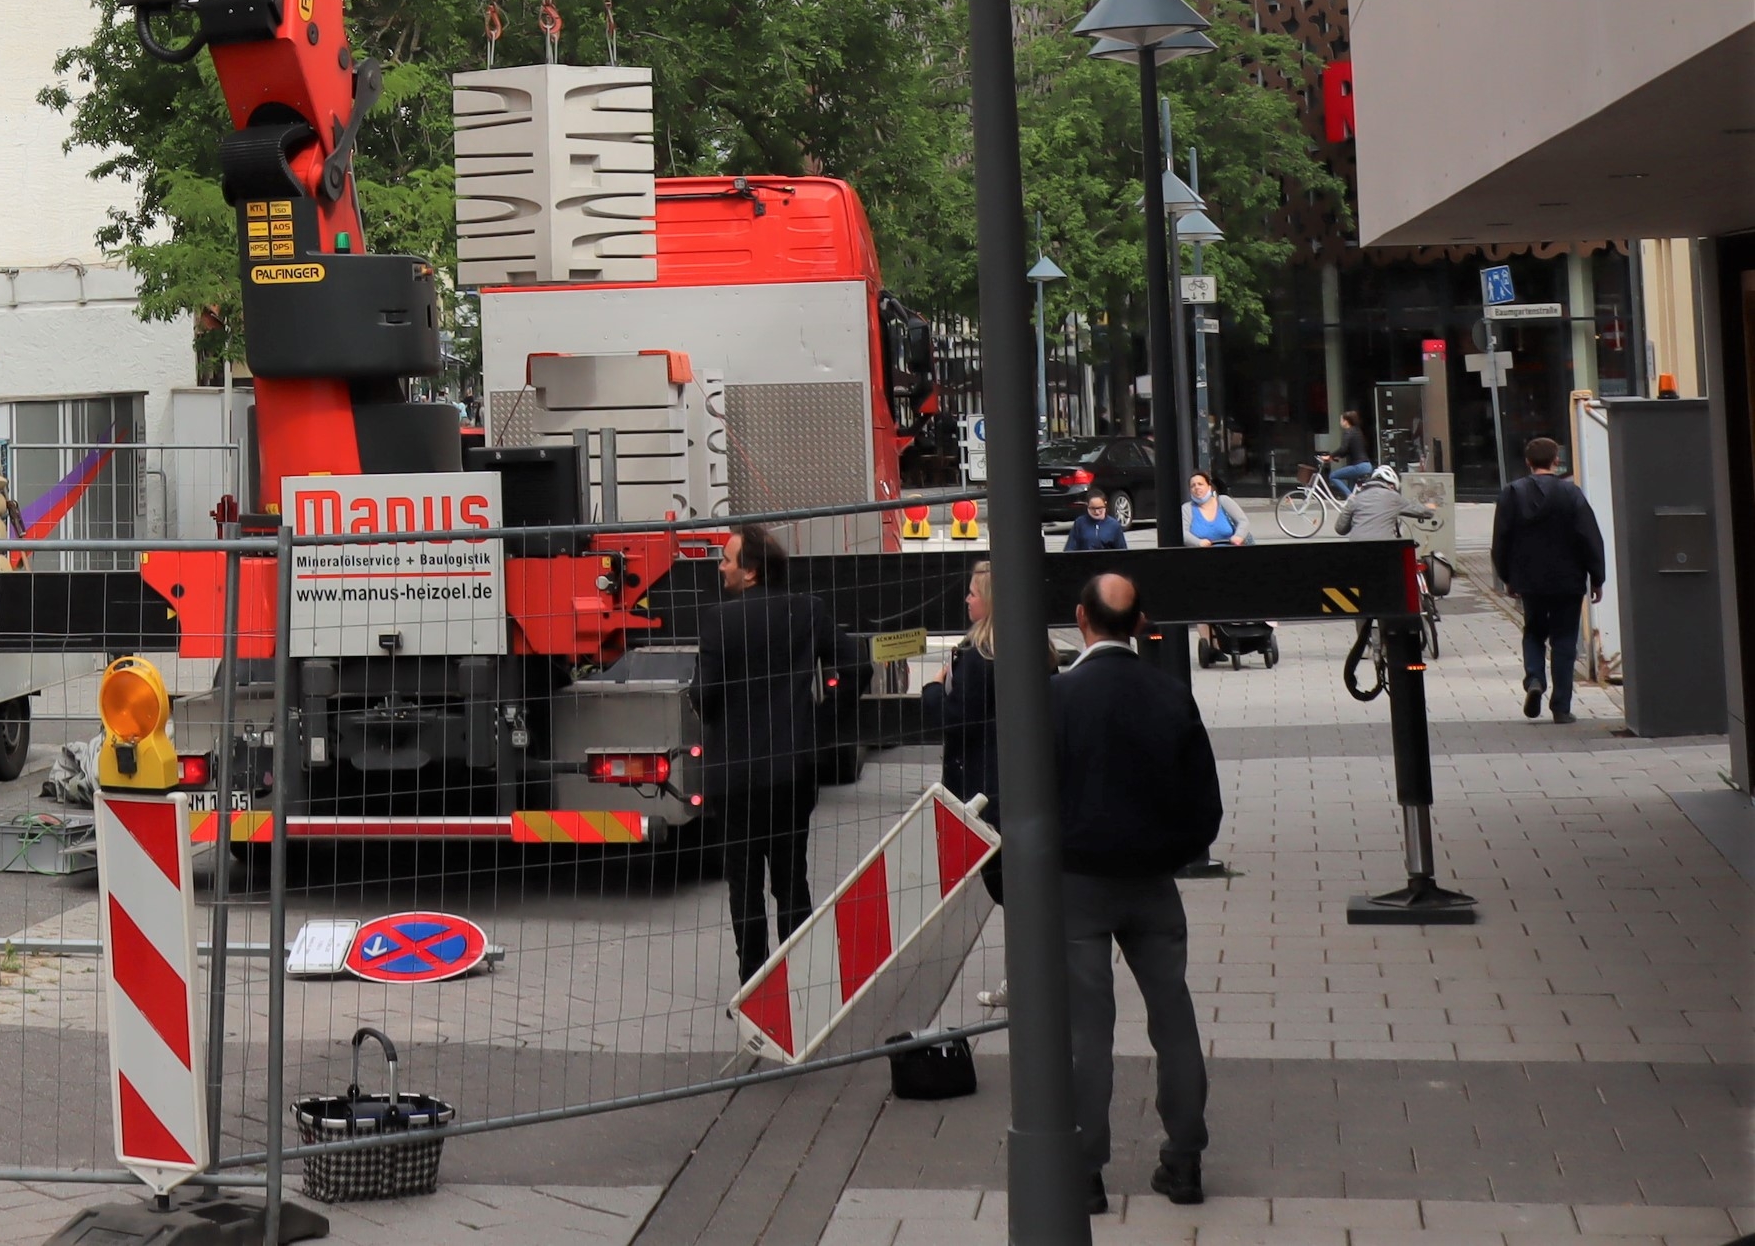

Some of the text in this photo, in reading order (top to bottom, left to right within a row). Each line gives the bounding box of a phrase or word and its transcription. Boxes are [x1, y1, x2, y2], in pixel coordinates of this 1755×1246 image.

[273, 223, 290, 231] AOS
[255, 267, 319, 280] PALFINGER
[1494, 306, 1558, 317] Baumgartenstraße
[296, 553, 491, 568] Mineralölservice + Baulogistik
[296, 582, 492, 602] www.manus-heizoel.de
